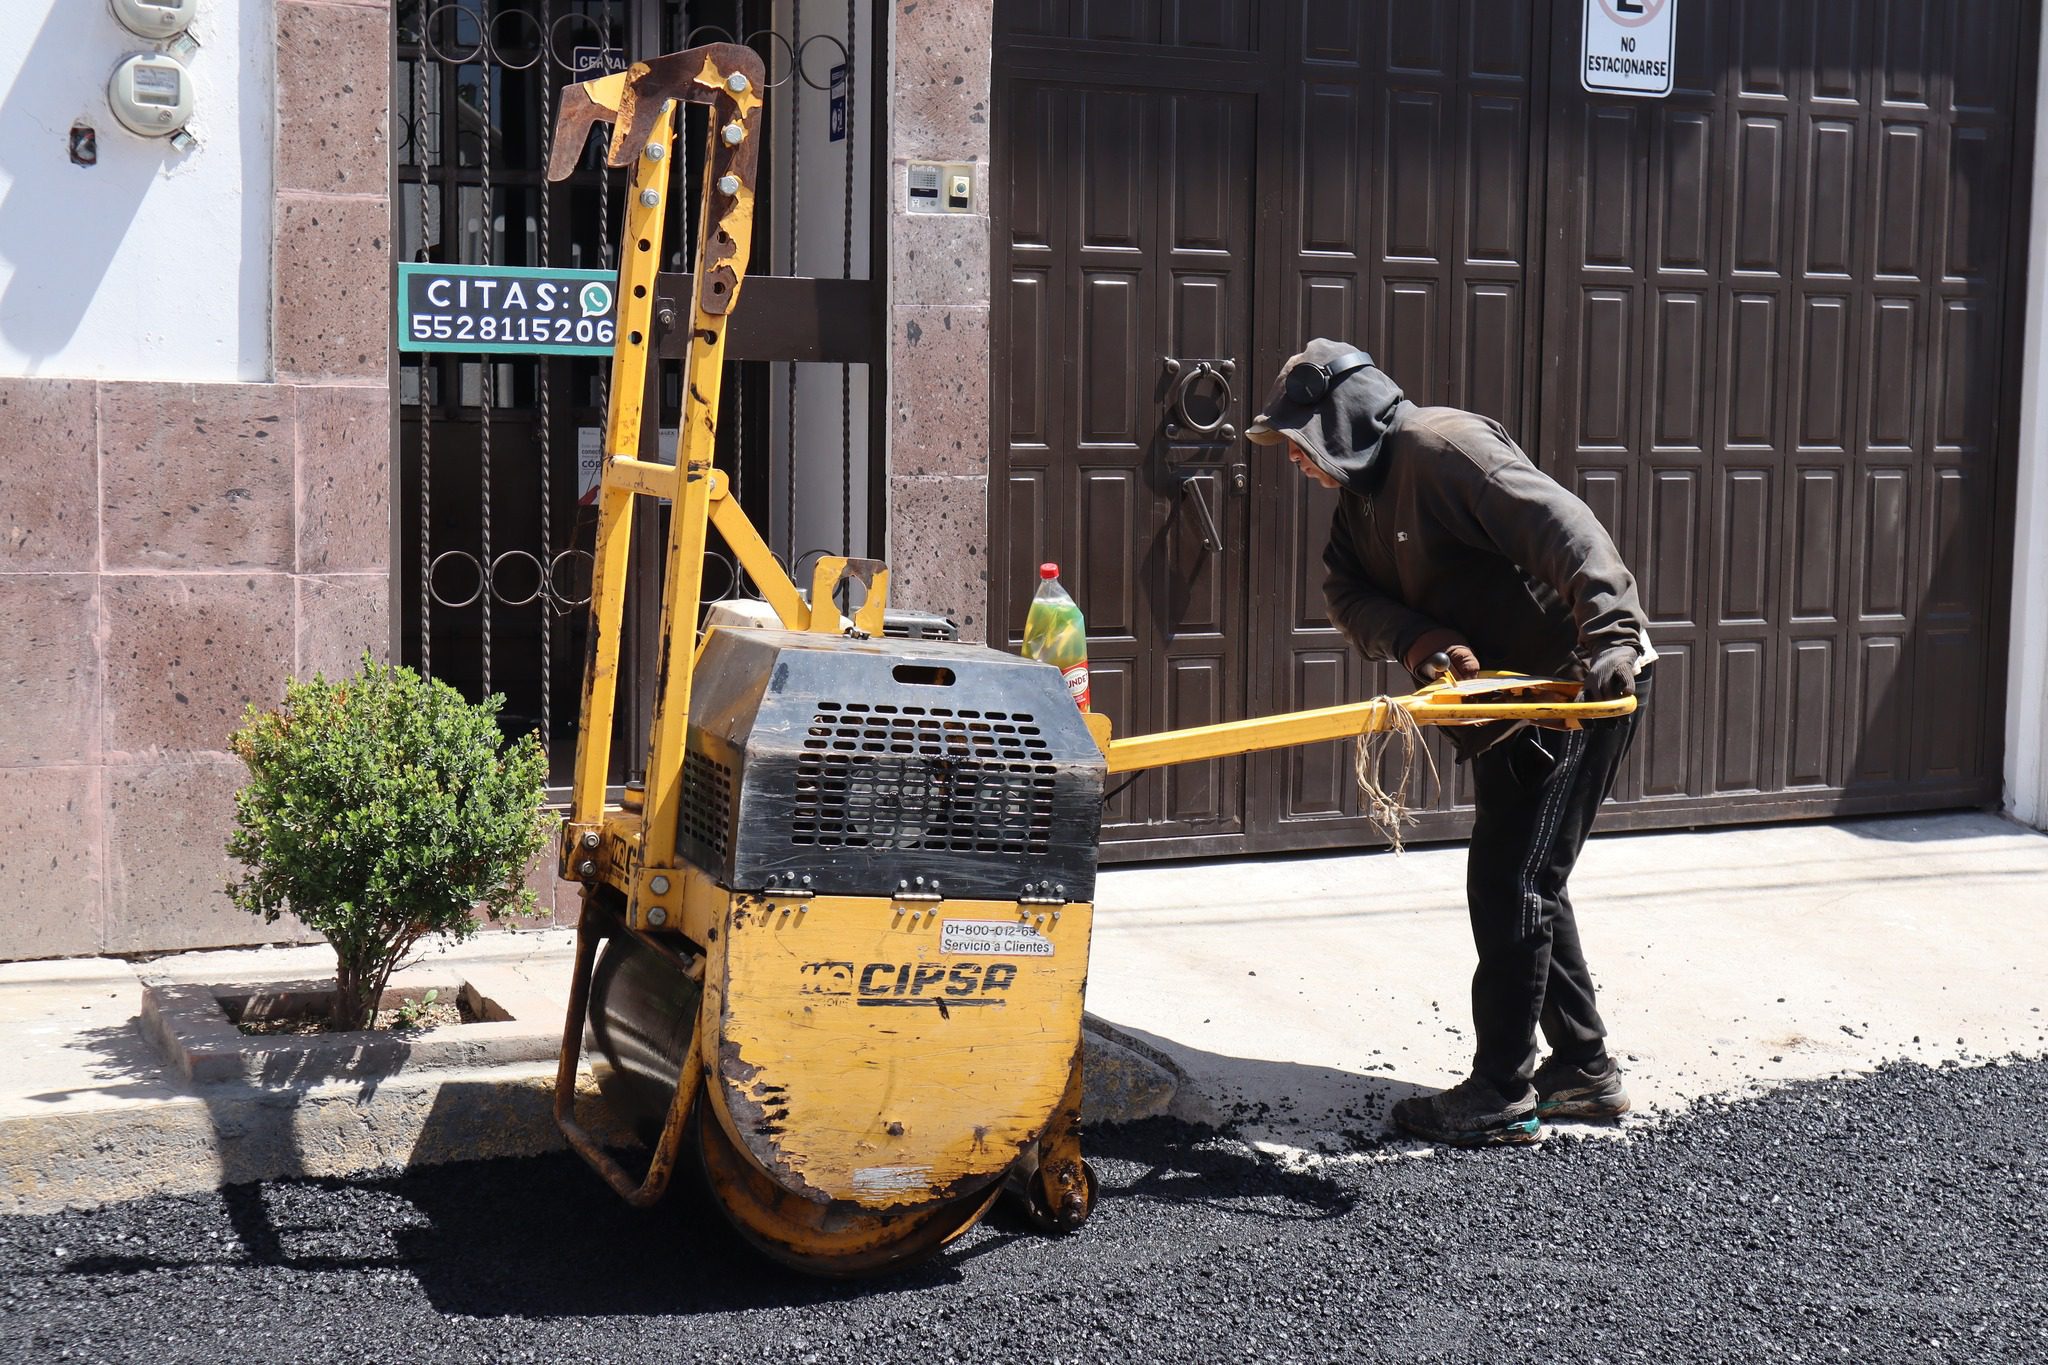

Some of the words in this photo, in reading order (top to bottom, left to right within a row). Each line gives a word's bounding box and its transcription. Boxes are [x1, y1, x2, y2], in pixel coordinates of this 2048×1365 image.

[1621, 37, 1636, 52] NO
[1588, 55, 1667, 77] ESTACIONARSE
[427, 279, 570, 311] CITAS:
[412, 314, 614, 343] 5528115206
[943, 938, 991, 952] Servicio
[994, 942, 1001, 952] a
[1004, 940, 1050, 953] Clientes
[858, 962, 1018, 997] CIPSA
